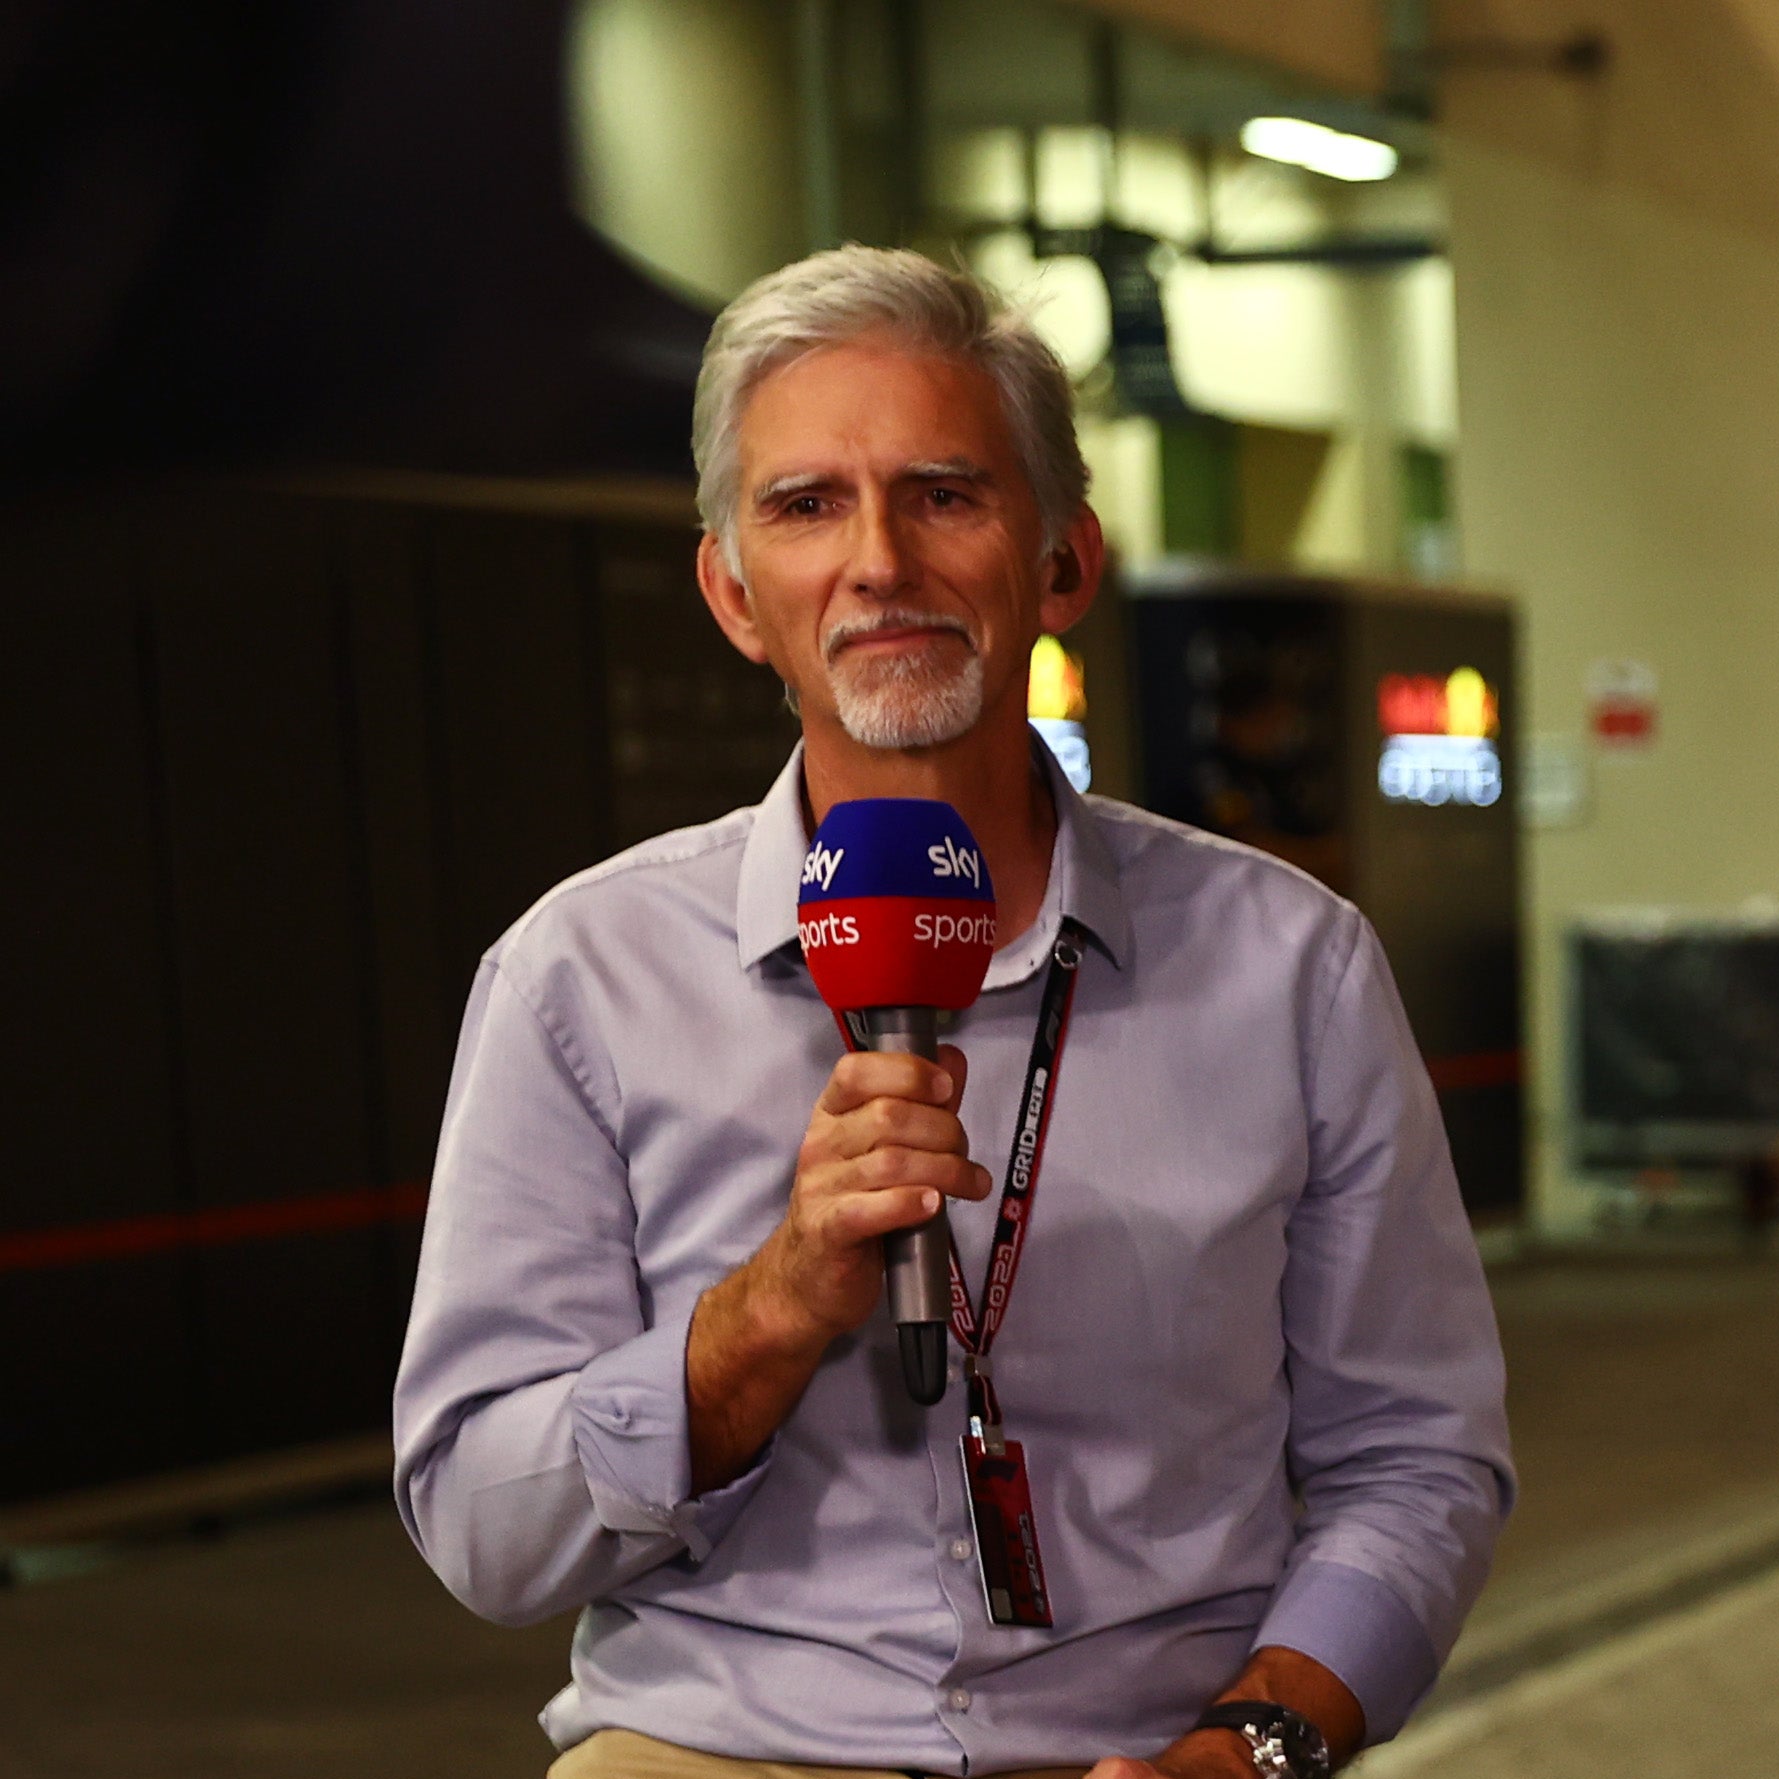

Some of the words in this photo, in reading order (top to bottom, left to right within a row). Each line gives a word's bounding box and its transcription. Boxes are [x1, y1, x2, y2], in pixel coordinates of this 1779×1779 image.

[802, 841, 844, 892] sky
[927, 835, 980, 890] sky
[798, 912, 860, 958] ports
[1012, 1128, 1037, 1191] GRID
[983, 1232, 1017, 1340] 2021
